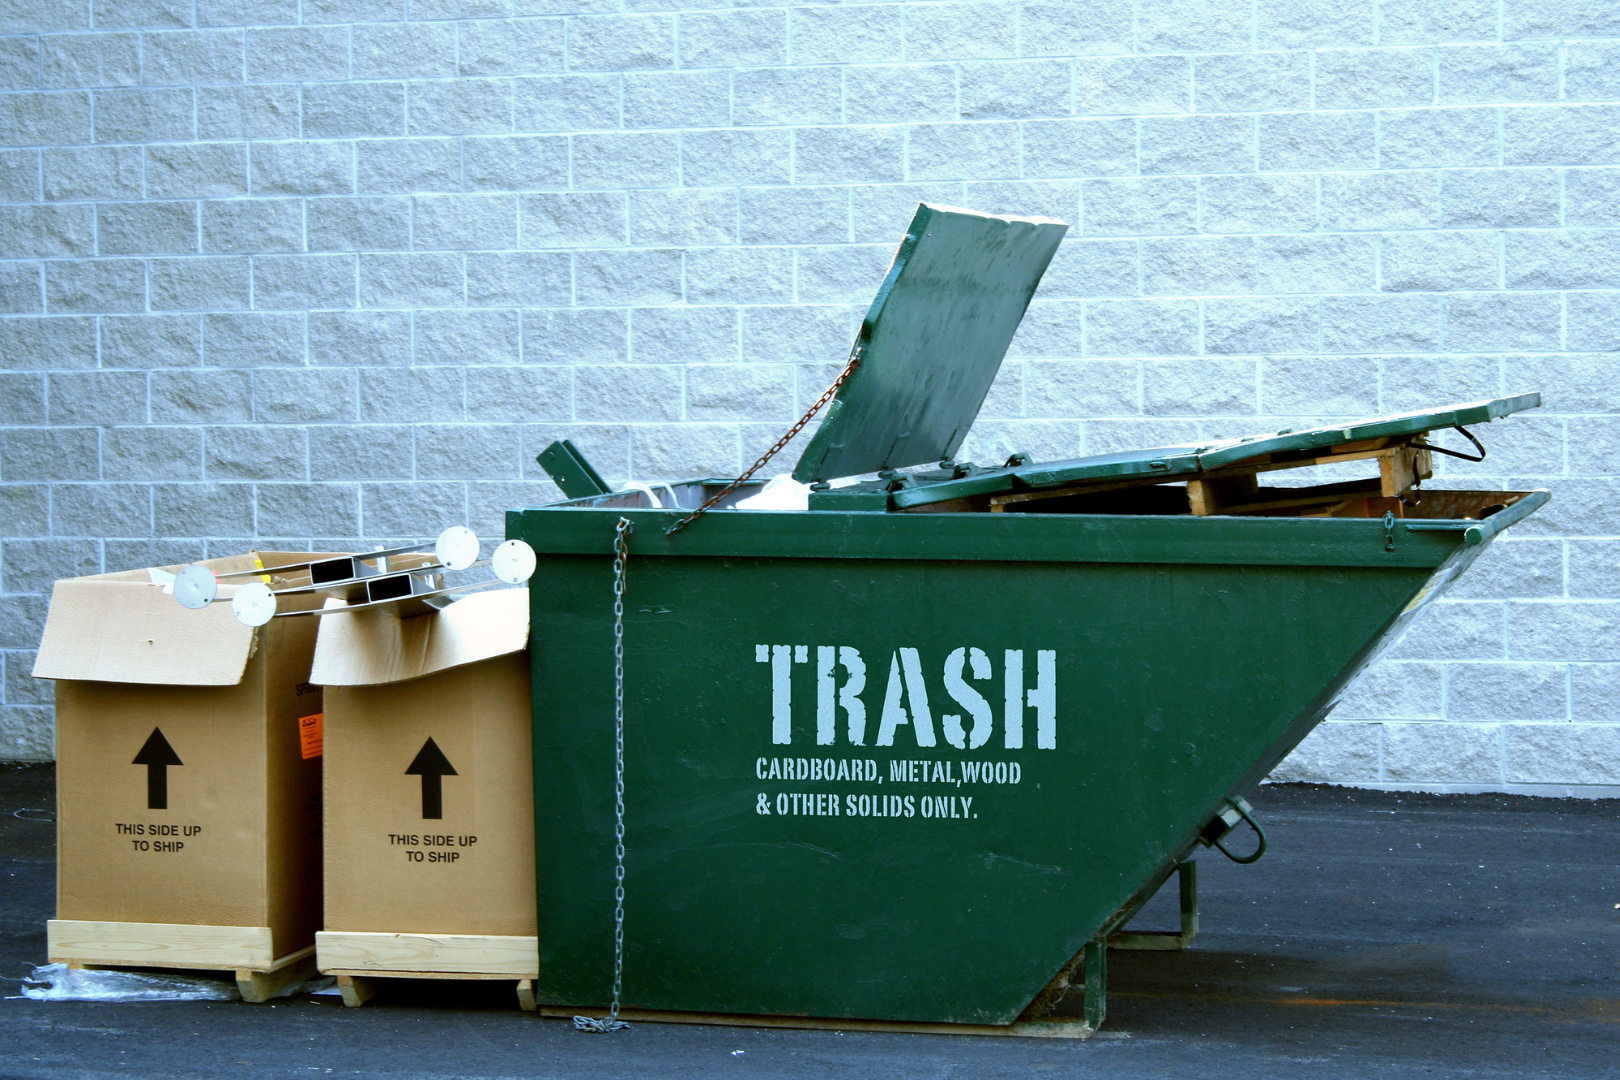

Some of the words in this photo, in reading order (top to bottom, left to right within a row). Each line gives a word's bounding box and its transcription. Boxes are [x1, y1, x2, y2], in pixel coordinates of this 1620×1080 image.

[755, 644, 1057, 750] TRASH
[756, 757, 883, 785] CARDBOARD,
[756, 792, 772, 816] &
[776, 793, 841, 817] OTHER
[846, 794, 915, 818] SOLIDS
[920, 795, 978, 819] ONLY.
[115, 822, 145, 836] THIS
[148, 824, 180, 837] SIDE
[183, 825, 202, 837] UP
[132, 839, 150, 852] TO
[153, 840, 185, 853] SHIP
[388, 833, 420, 846] THIS
[423, 834, 455, 847] SIDE
[458, 835, 478, 847] UP
[406, 850, 425, 863] TO
[428, 851, 460, 863] SHIP
